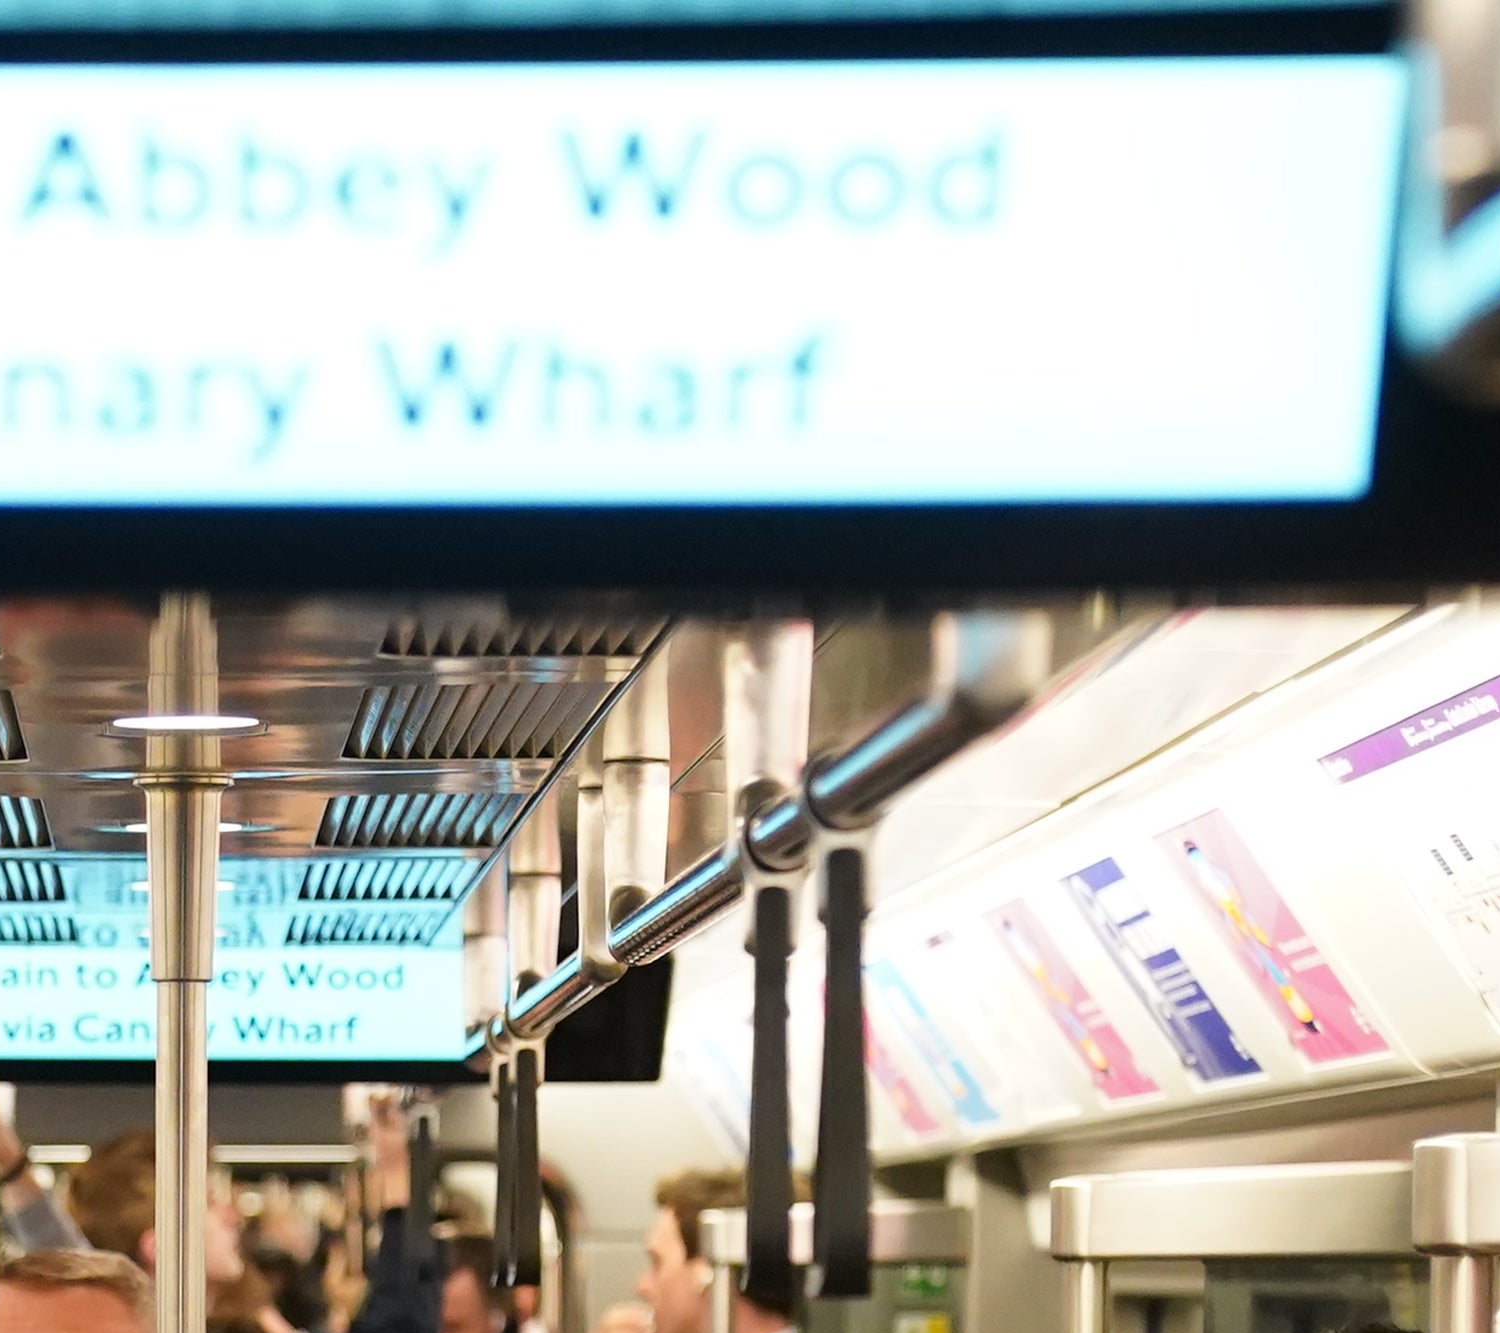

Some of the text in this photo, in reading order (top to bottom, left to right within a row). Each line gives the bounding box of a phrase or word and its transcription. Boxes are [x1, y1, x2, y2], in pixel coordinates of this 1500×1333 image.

[18, 125, 494, 262] Abbey
[554, 124, 1006, 226] Wood
[370, 326, 836, 432] Wharf
[75, 963, 119, 989] to
[134, 961, 266, 998] Aey
[282, 962, 405, 990] Wood
[2, 1014, 57, 1042] via
[232, 1015, 357, 1042] Wharf
